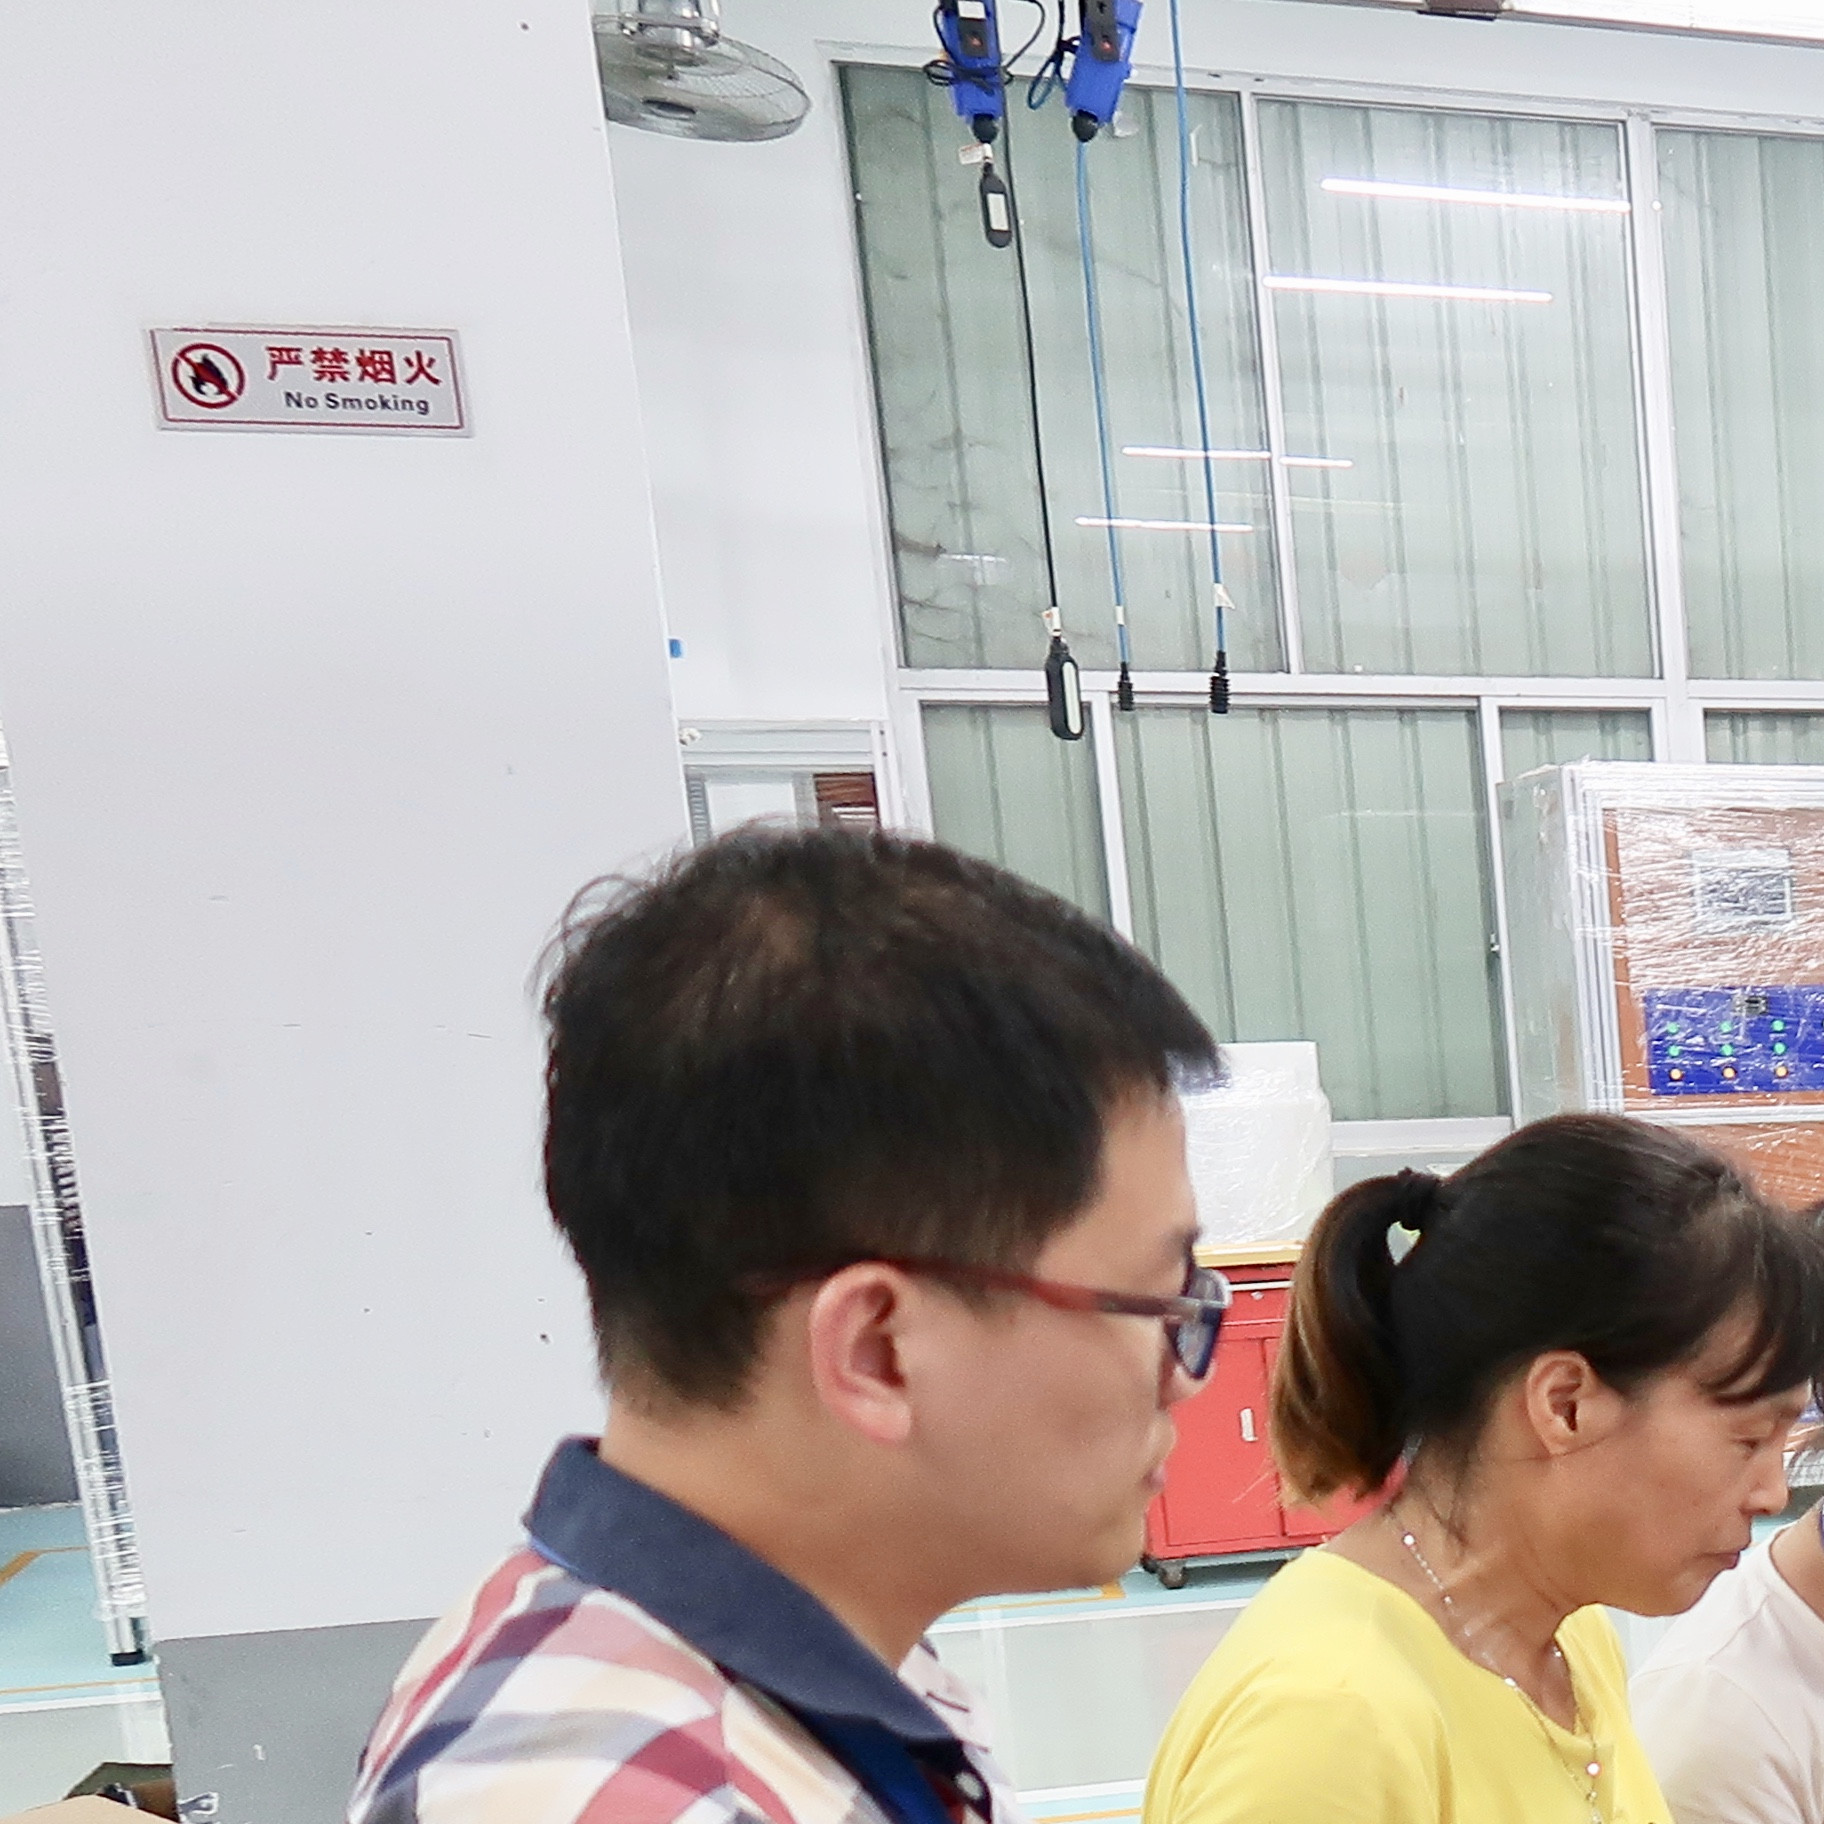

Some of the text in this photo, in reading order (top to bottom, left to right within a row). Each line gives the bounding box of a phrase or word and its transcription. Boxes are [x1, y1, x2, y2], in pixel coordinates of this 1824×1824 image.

[266, 346, 442, 386] 严禁烟火
[285, 391, 430, 416] No Smoking
